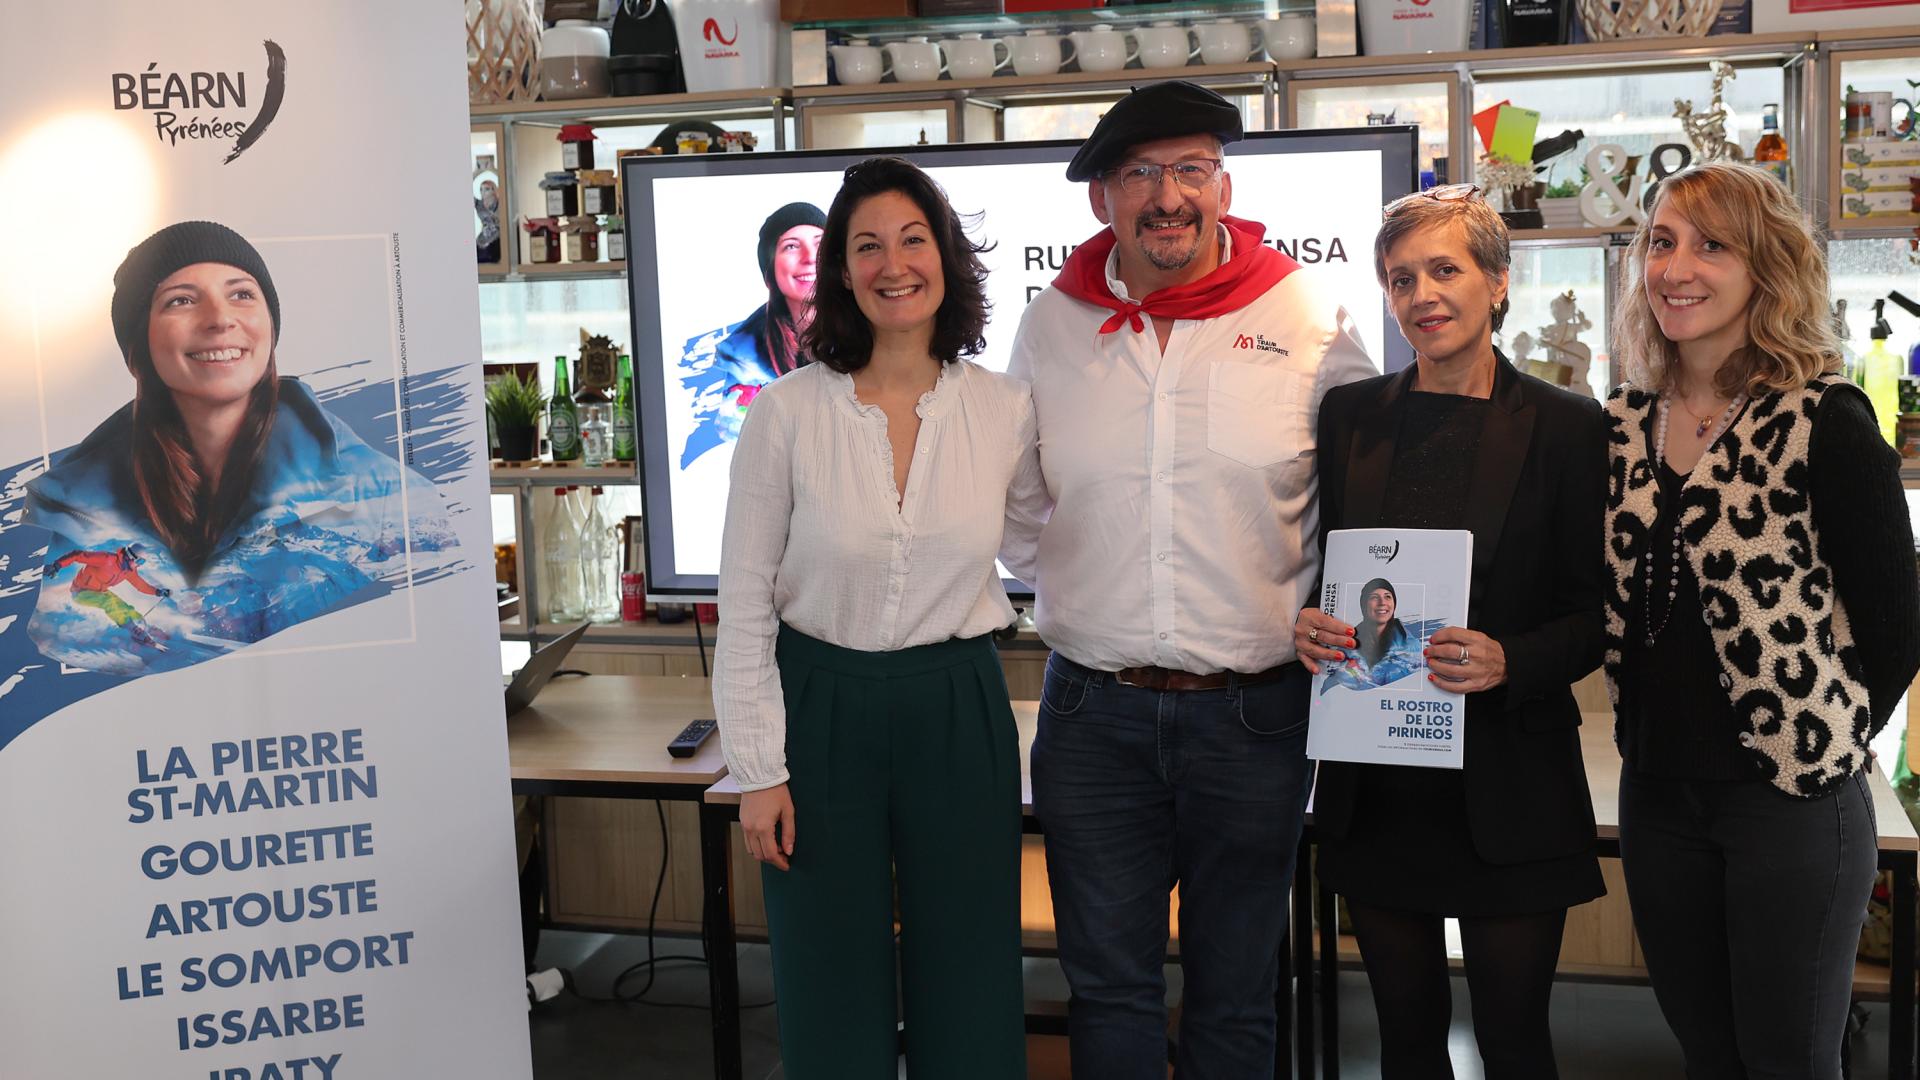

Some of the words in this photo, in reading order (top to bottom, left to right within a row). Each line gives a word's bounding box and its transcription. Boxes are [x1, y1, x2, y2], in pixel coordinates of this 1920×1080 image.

[112, 62, 247, 110] BÉARN
[153, 111, 247, 147] Pyrénées
[1025, 245, 1078, 271] RU
[1263, 238, 1348, 264] NSA
[1368, 544, 1392, 554] BÉARN
[1380, 699, 1394, 711] EL
[1397, 700, 1453, 713] ROSTRO
[1405, 713, 1422, 725] DE
[1426, 714, 1453, 727] LOS
[136, 746, 198, 784] LA
[211, 728, 364, 776] PIERRE
[1388, 726, 1453, 740] PIRINEOS
[128, 765, 378, 824] ST-MARTIN
[141, 822, 374, 880] GOURETTE
[145, 879, 378, 939] ARTOUSTE
[117, 962, 164, 1001] LE
[180, 931, 414, 993] SOMPORT
[177, 994, 365, 1051] ISSARBE
